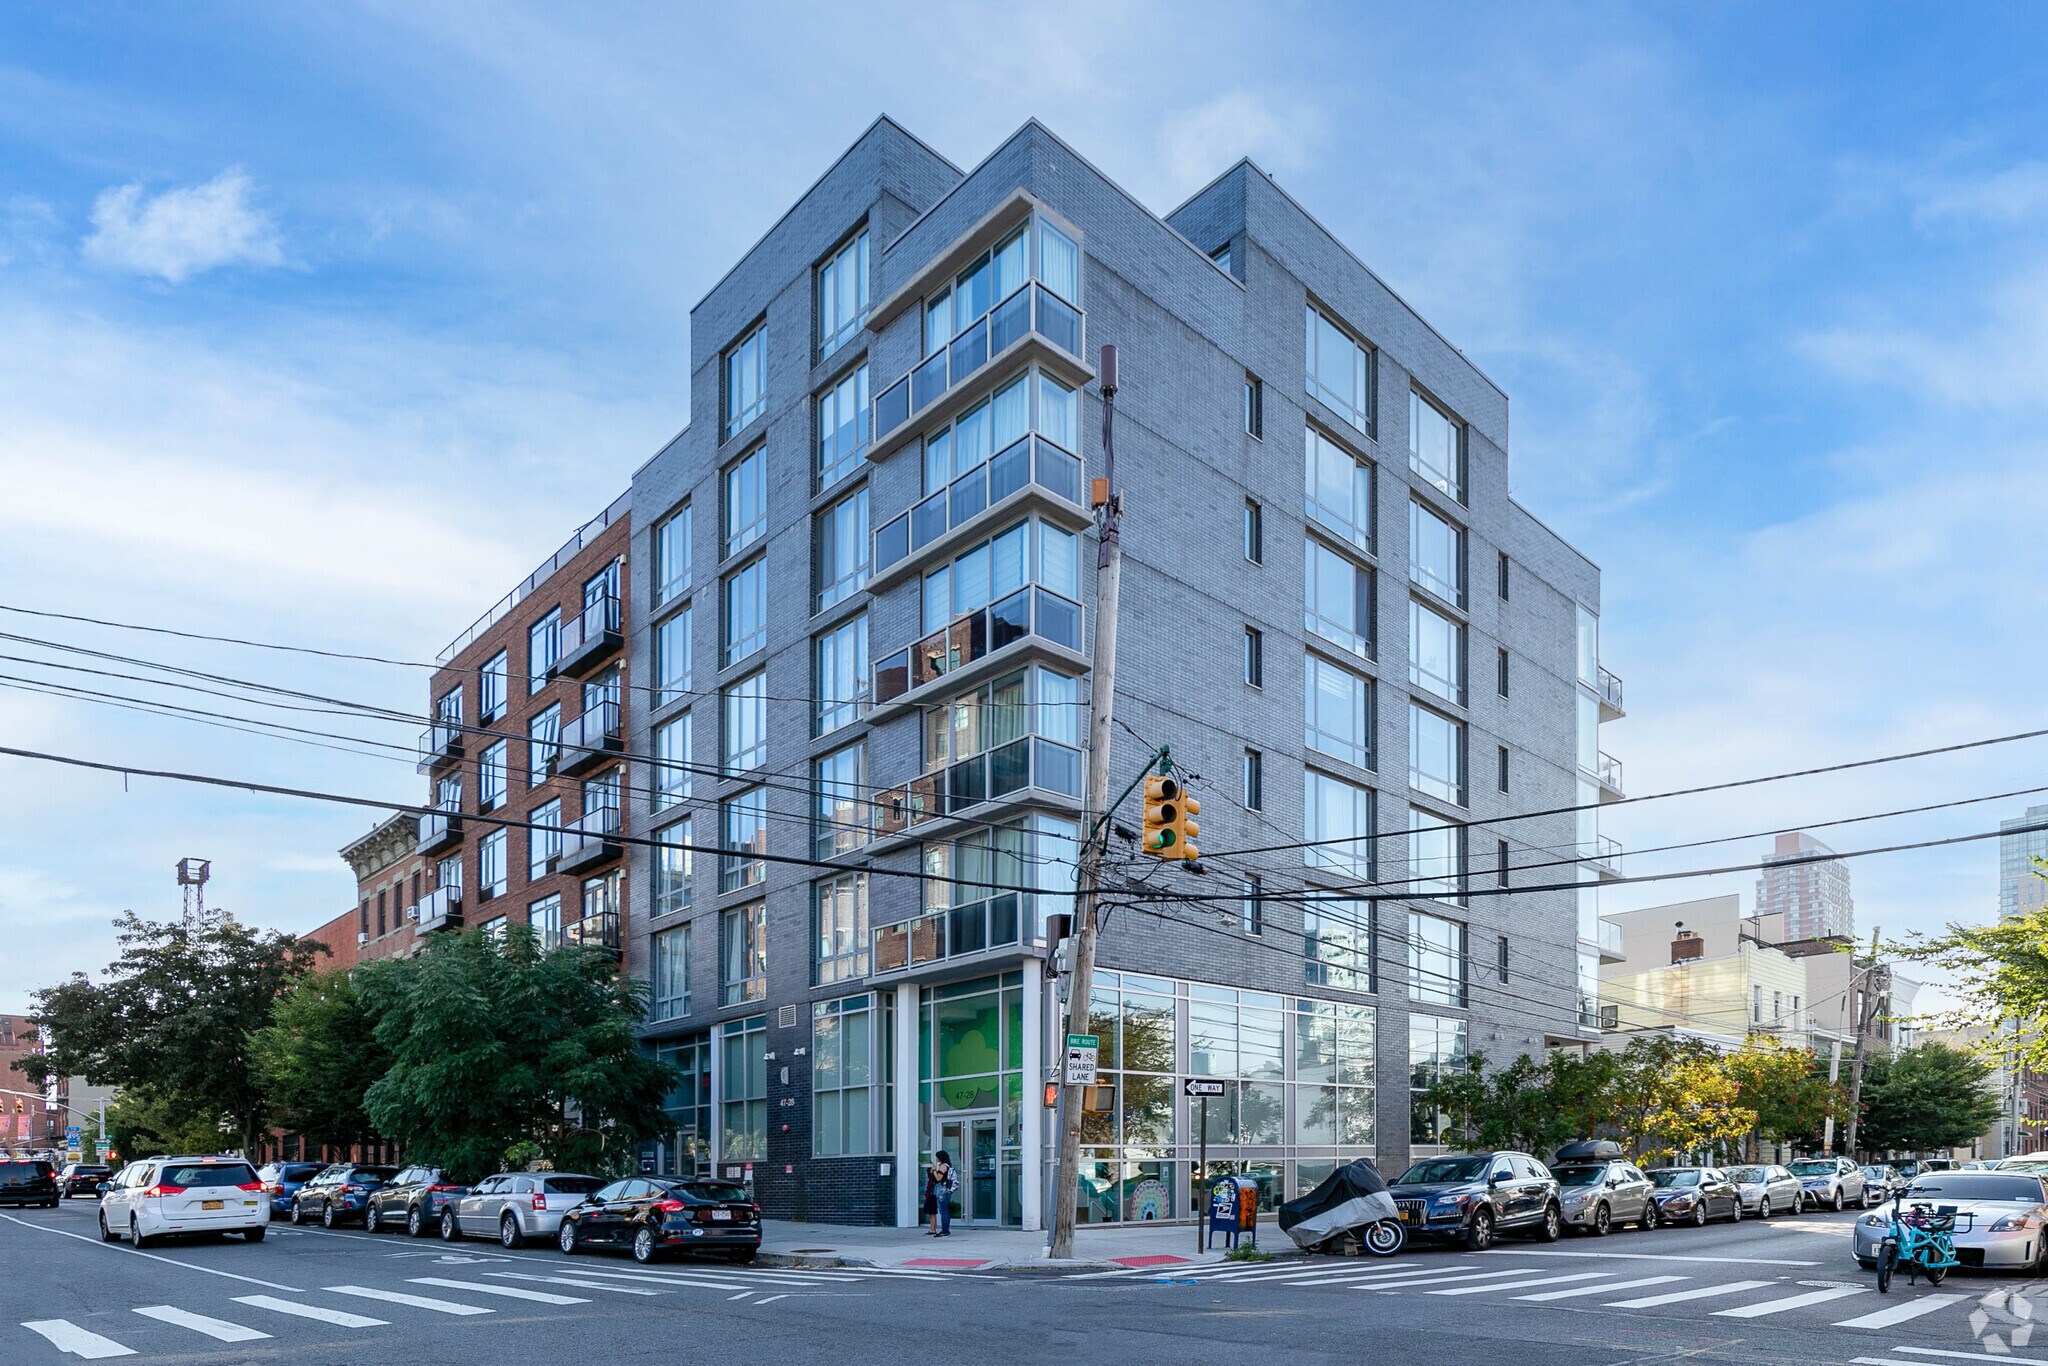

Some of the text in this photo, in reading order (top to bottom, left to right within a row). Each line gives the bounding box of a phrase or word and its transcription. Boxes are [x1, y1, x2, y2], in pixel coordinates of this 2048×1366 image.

[1069, 1062, 1095, 1072] SHARED
[1072, 1072, 1090, 1081] LANE
[1190, 1083, 1221, 1092] ONE WAY
[955, 1091, 974, 1100] 47-28
[780, 1098, 795, 1106] 47-28
